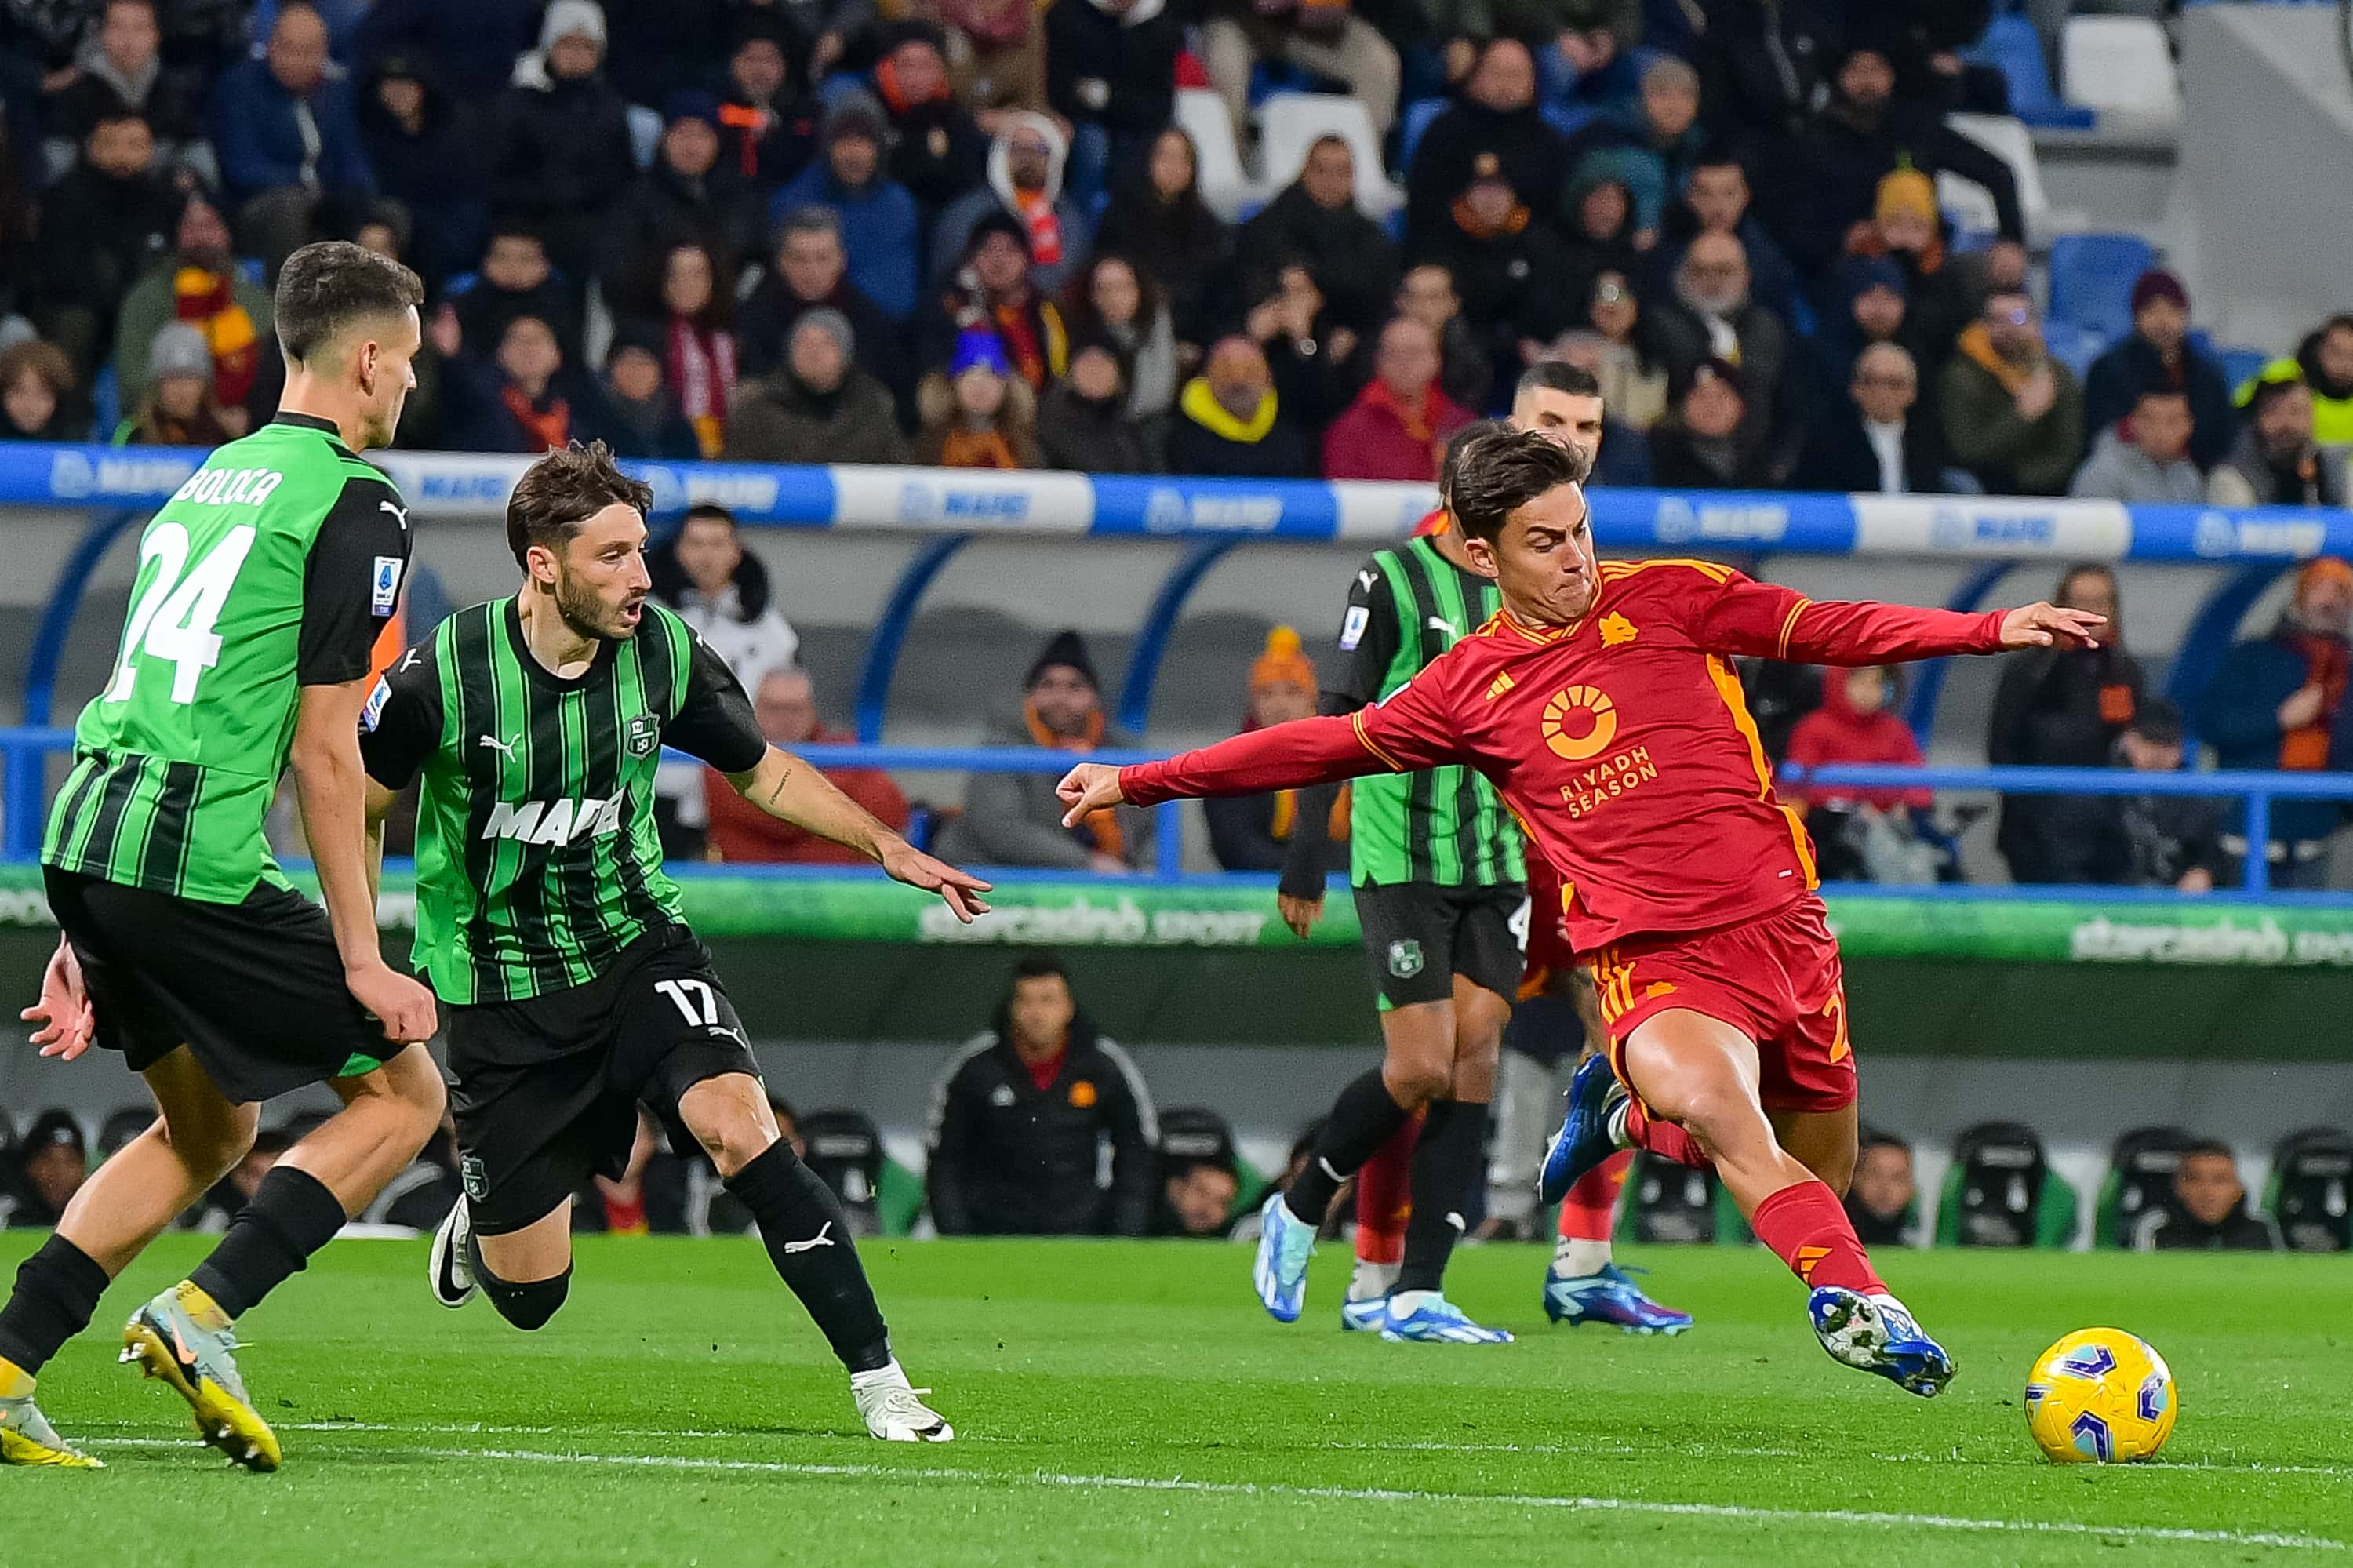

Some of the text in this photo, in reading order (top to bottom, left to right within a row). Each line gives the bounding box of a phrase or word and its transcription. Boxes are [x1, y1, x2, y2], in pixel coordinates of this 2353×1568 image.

[174, 467, 283, 507] BOLOCA
[103, 521, 257, 704] 24
[1559, 745, 1649, 802] RIYADH
[1568, 762, 1658, 819] SEASON
[654, 979, 718, 1027] 17
